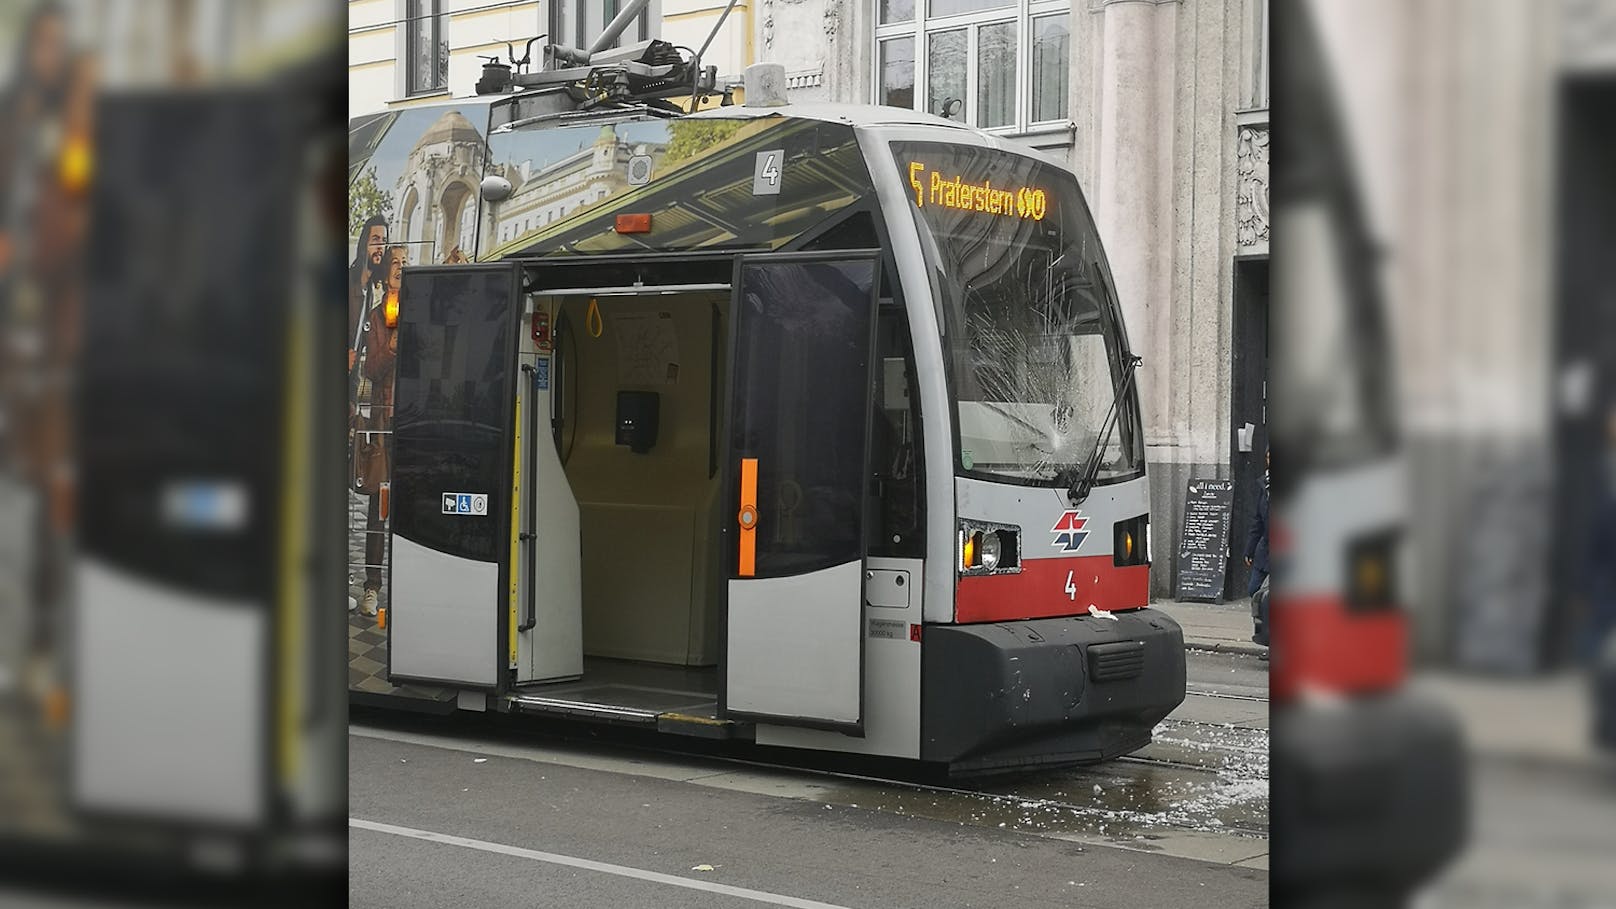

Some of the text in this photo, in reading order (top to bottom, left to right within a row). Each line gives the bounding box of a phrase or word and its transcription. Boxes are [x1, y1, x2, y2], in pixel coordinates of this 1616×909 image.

[761, 154, 778, 186] 4
[909, 161, 924, 208] 5
[930, 171, 1014, 216] Praterstern
[1064, 569, 1077, 601] 4
[912, 624, 921, 640] A
